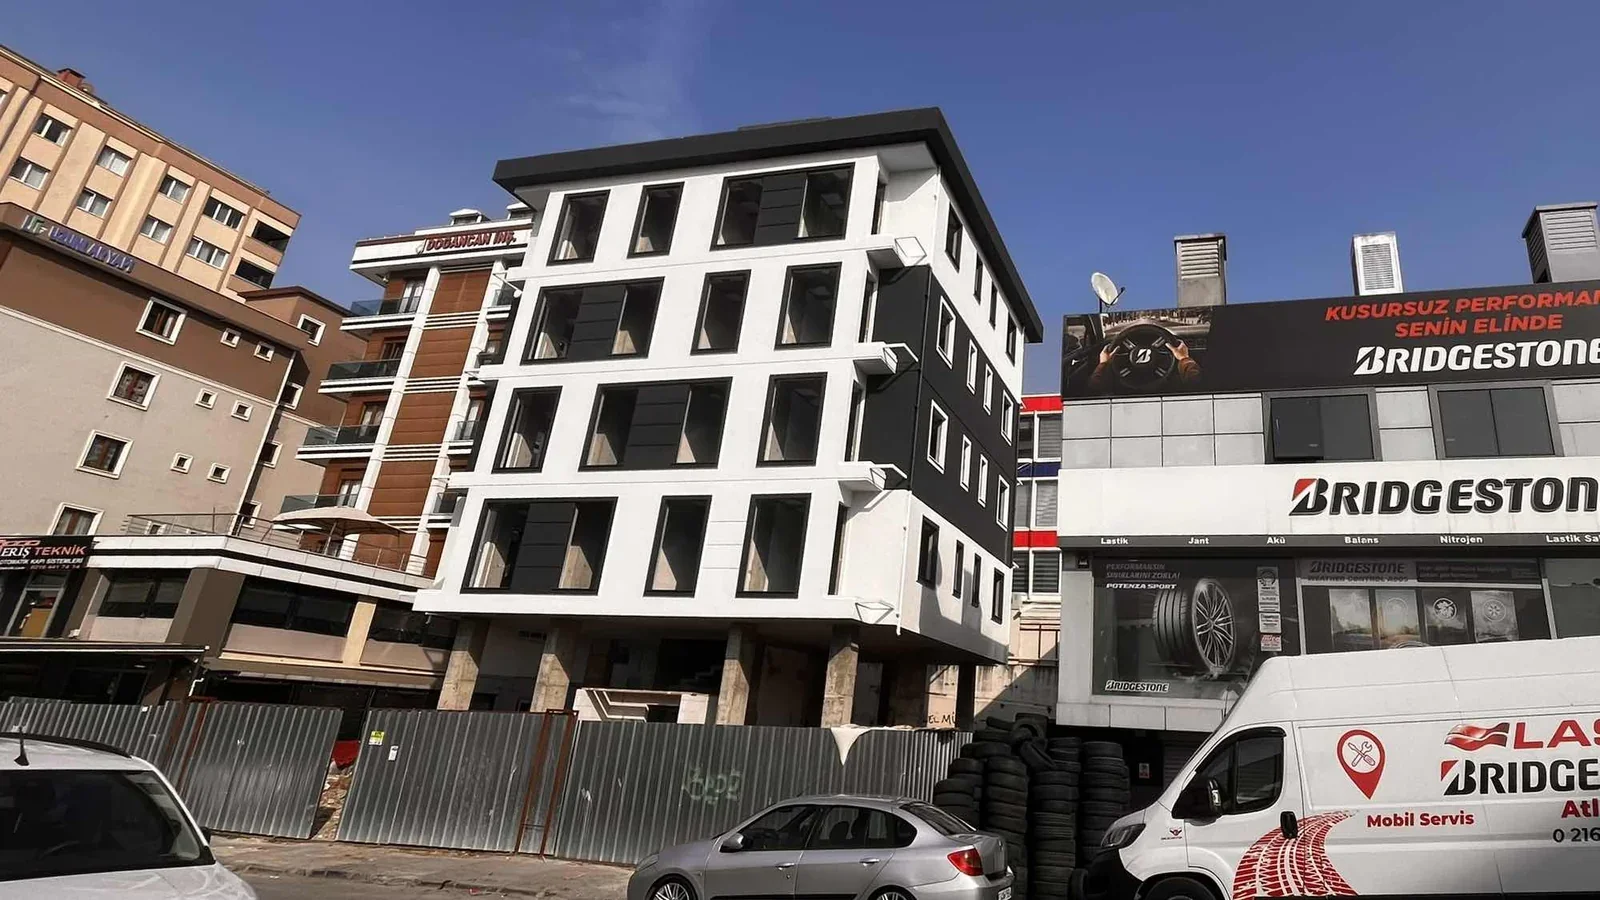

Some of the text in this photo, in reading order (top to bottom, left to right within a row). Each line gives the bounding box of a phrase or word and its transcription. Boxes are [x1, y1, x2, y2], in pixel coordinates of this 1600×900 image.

[1325, 300, 1450, 321] KUSURSUZ
[1395, 313, 1563, 338] SENİN ELİNDE
[1289, 477, 1599, 516] BRIDGESTON
[1100, 534, 1600, 546] Lastik Jant Akü Balans Nitrojen Lastik Sa
[34, 545, 87, 556] TEKNİK
[1309, 560, 1405, 574] BRIDGESTONE
[1105, 680, 1170, 693] BRIDGESTONE
[1513, 719, 1600, 750] LA
[1440, 758, 1600, 796] BRIDGE
[1367, 810, 1475, 827] Mobil Servis
[1553, 827, 1600, 843] 0 216
